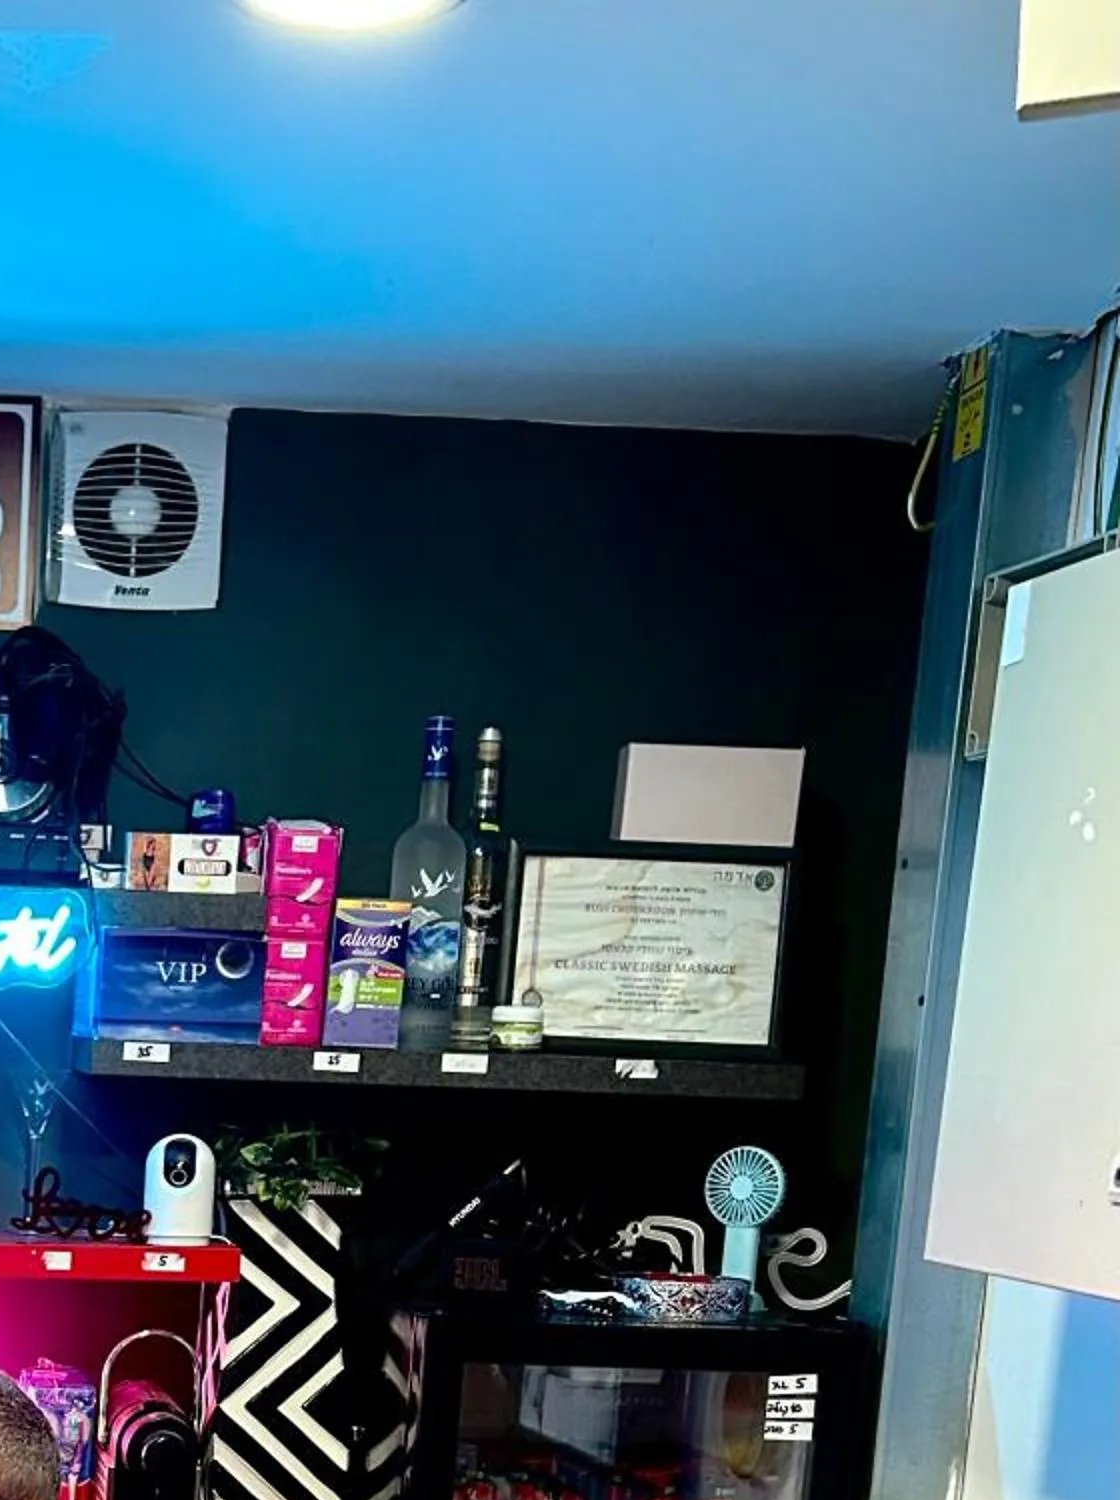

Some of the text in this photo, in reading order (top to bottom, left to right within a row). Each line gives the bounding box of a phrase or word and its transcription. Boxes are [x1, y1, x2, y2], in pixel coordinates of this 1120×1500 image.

[339, 928, 402, 961] always
[155, 961, 208, 983] VIP
[674, 962, 738, 976] MASSAGE
